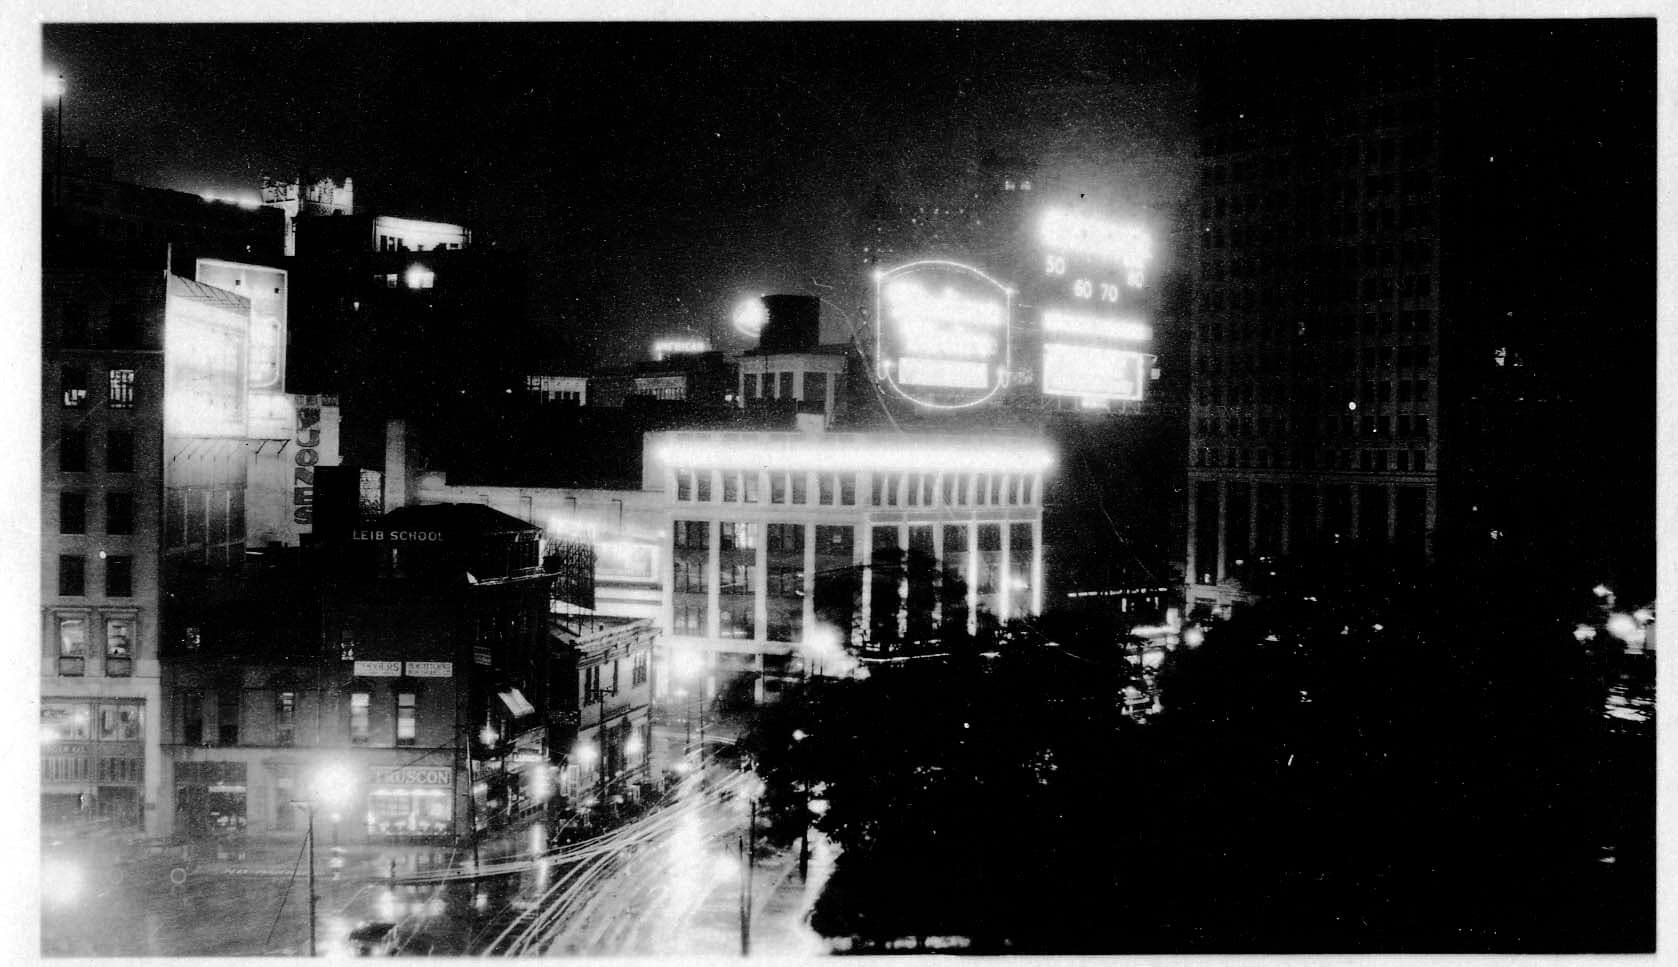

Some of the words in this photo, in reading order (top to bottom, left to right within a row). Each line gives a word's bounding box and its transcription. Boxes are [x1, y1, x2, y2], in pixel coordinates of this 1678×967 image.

[1046, 254, 1066, 275] 50
[1099, 282, 1118, 303] 70
[389, 530, 444, 542] SCHOOL
